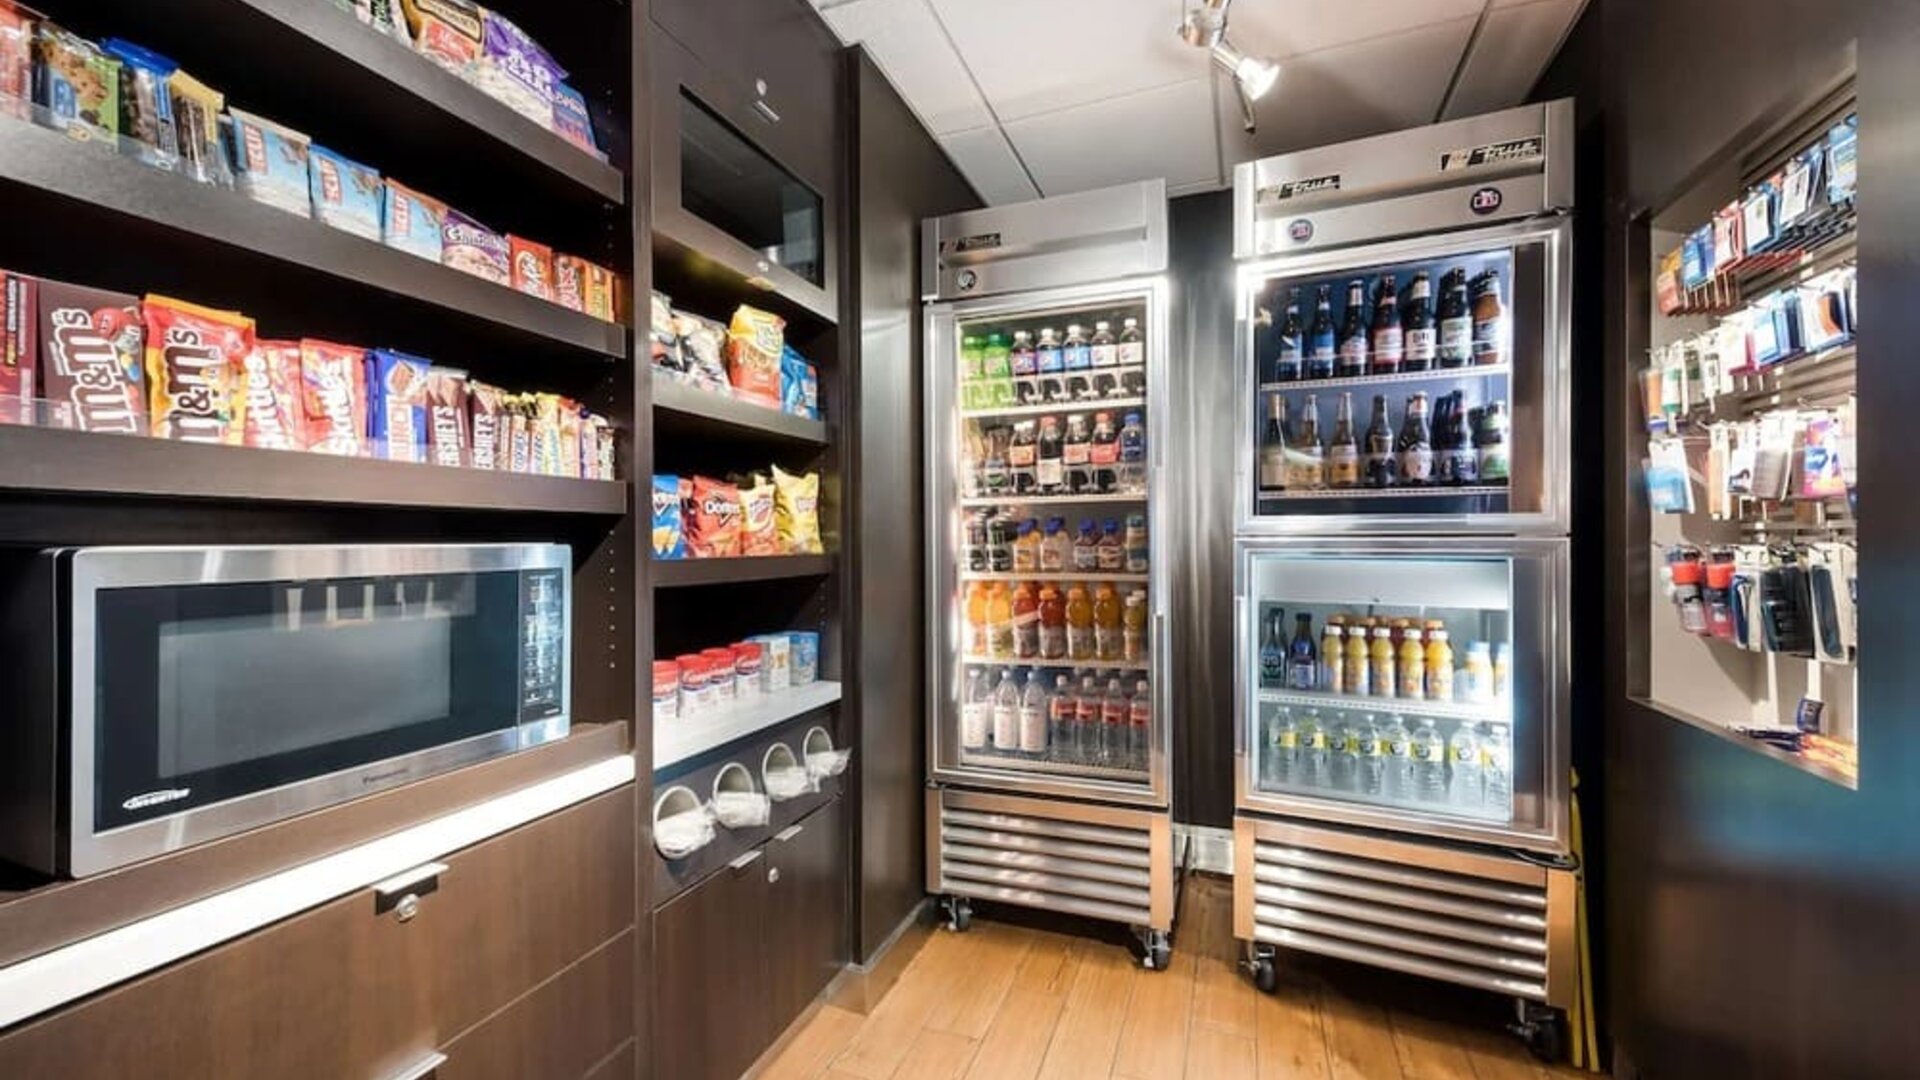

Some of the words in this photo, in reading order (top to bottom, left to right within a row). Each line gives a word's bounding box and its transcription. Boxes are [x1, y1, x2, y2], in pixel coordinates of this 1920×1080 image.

[244, 350, 288, 448] kittles
[433, 405, 461, 467] ERSHEY'S
[474, 413, 495, 469] ERSHEY'S
